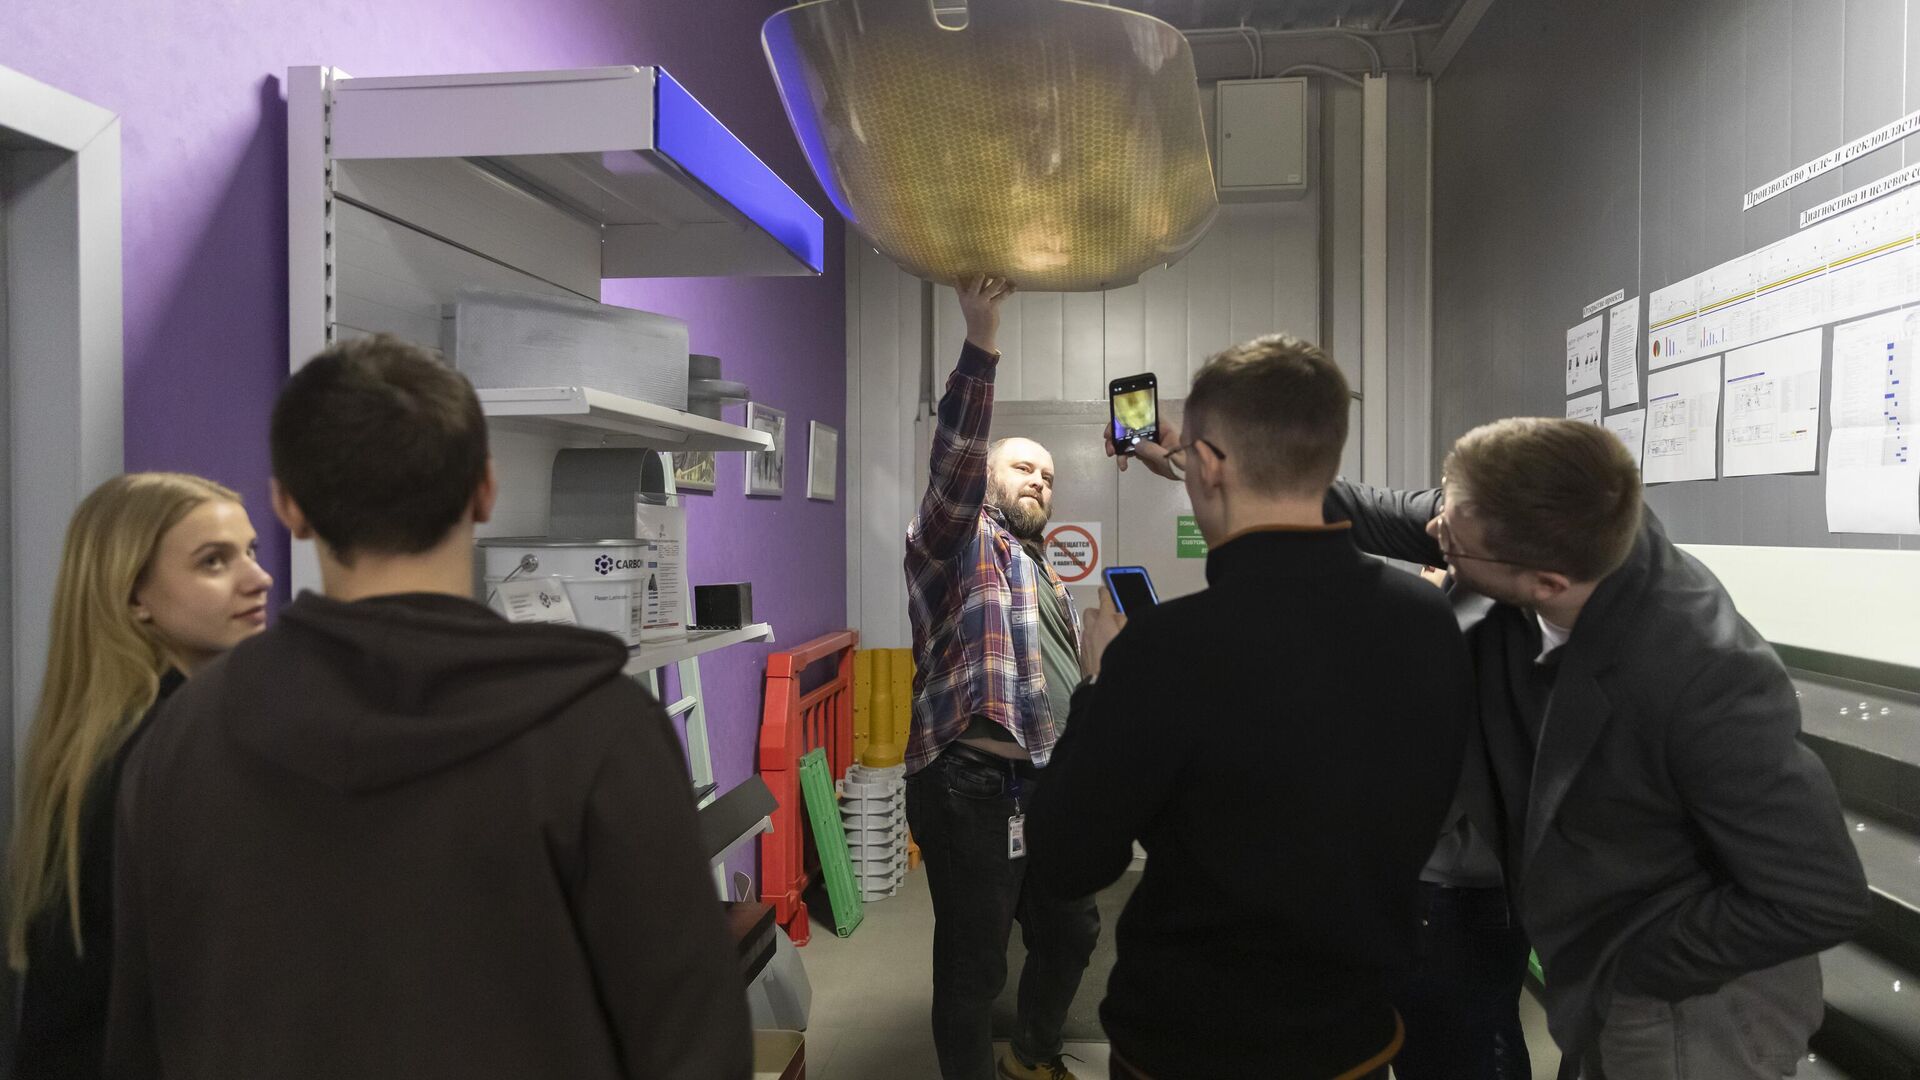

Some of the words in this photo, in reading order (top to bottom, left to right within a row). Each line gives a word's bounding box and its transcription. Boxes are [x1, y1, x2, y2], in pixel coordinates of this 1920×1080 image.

[1747, 170, 1804, 205] Производство
[1808, 157, 1832, 179] угле-
[1834, 153, 1841, 163] и
[1800, 193, 1857, 226] Диагностика
[1861, 189, 1866, 200] и
